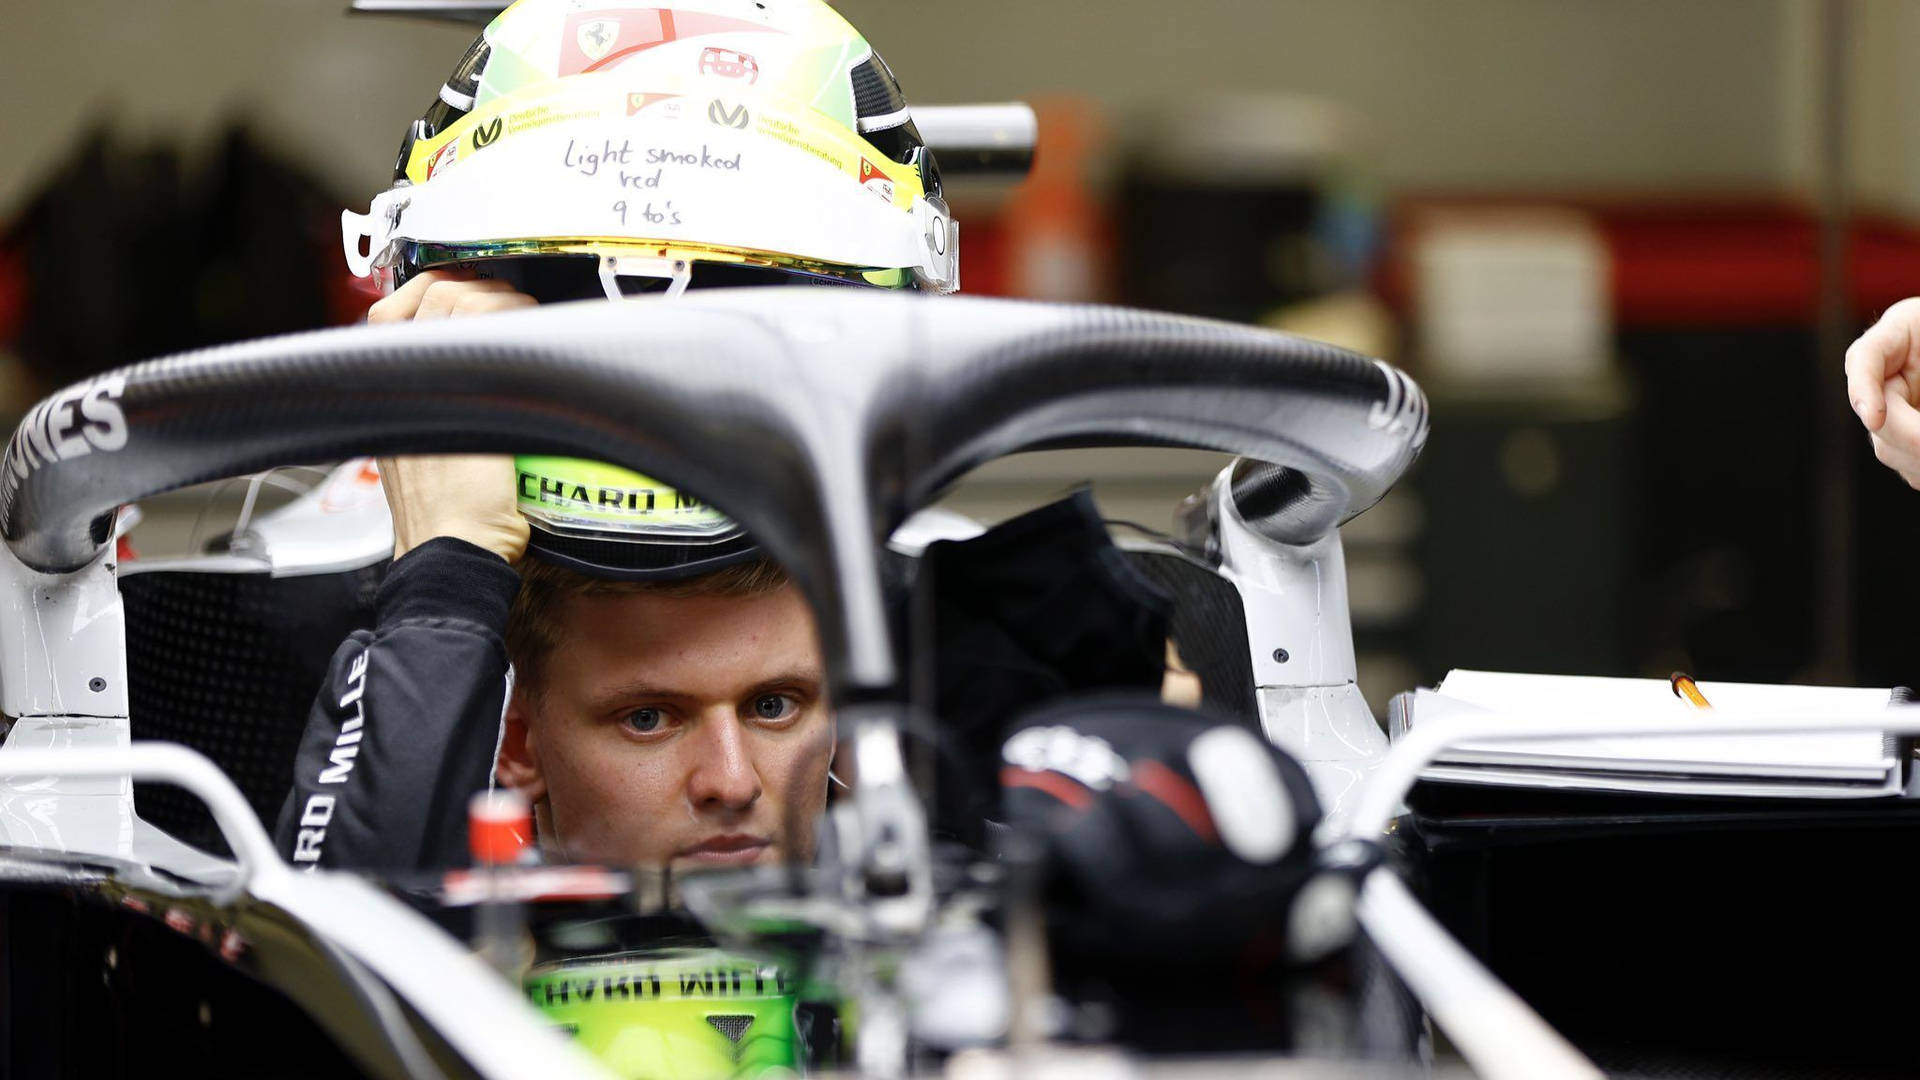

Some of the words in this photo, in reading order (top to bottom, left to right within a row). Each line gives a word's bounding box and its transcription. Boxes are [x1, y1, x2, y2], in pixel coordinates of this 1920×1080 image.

[563, 139, 633, 176] Light
[645, 144, 742, 171] smoked
[619, 168, 662, 189] red
[318, 649, 370, 784] MILLE
